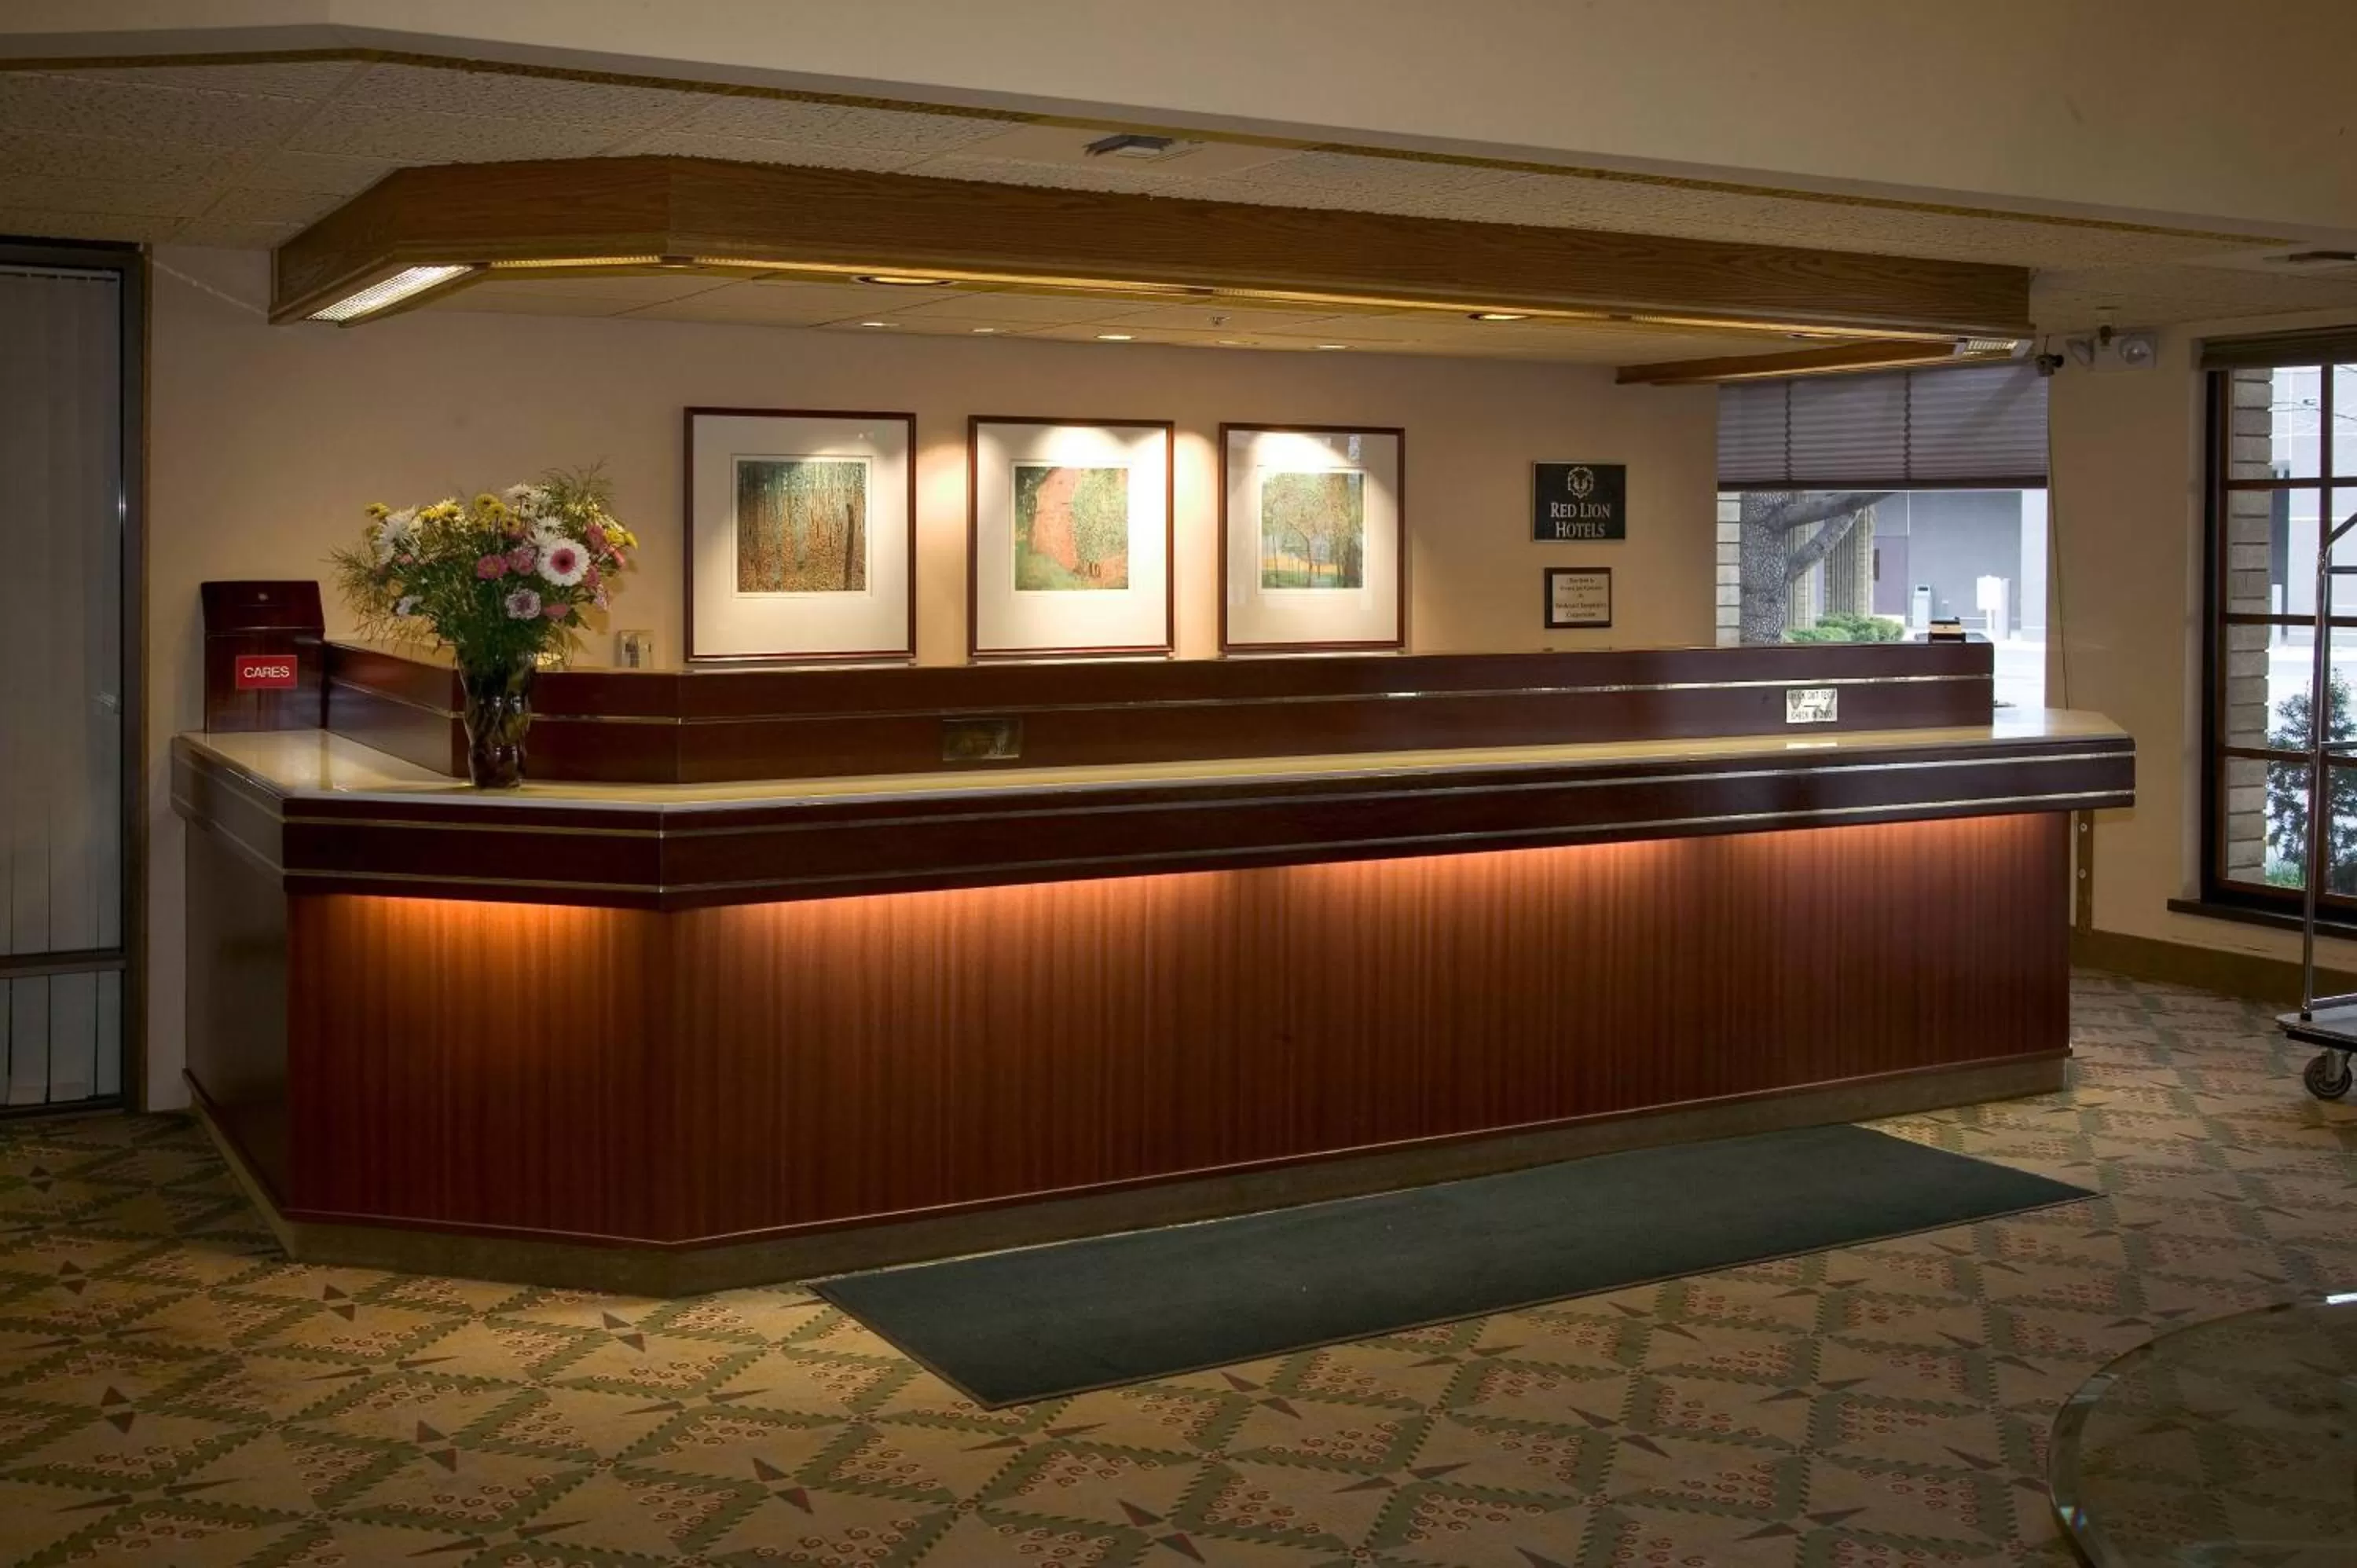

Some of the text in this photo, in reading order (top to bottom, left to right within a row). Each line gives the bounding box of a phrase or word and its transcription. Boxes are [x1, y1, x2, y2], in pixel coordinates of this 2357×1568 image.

[1550, 502, 1611, 518] RED LION
[1556, 522, 1606, 538] HOTELS
[244, 666, 290, 678] CARES
